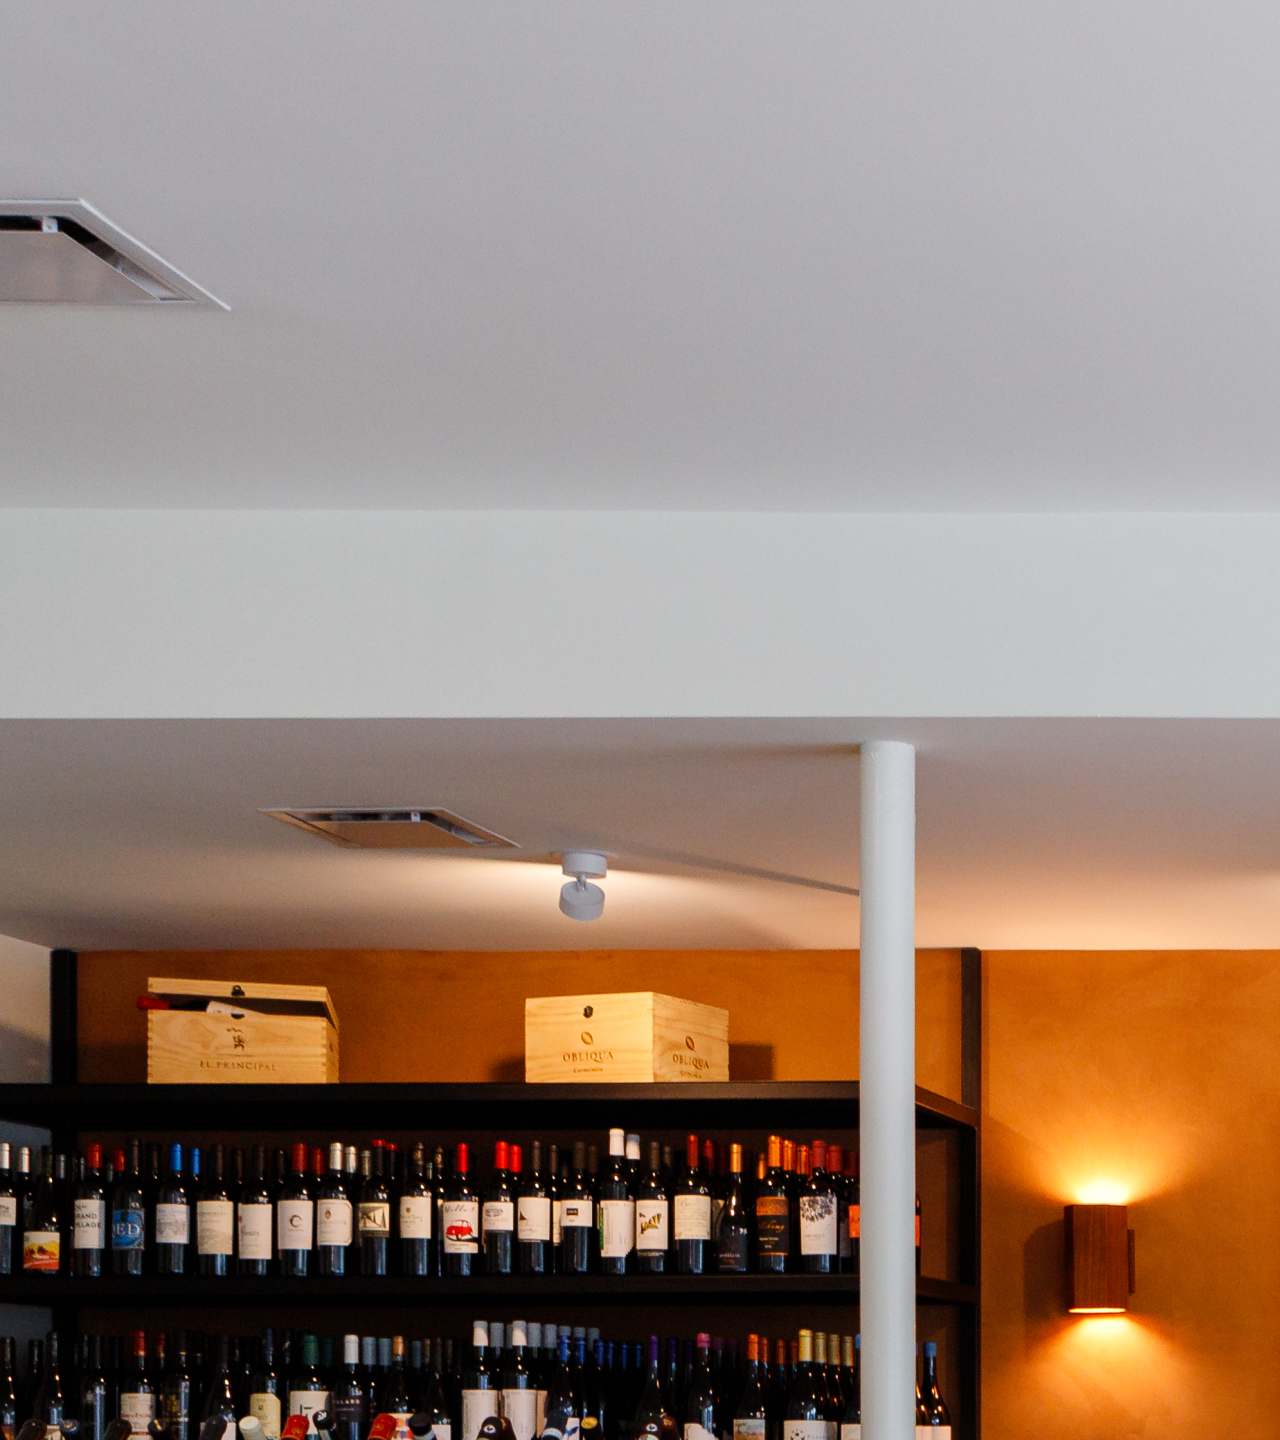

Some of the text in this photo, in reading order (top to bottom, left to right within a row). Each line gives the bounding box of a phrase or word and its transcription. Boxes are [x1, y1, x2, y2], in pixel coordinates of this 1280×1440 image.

[562, 1050, 614, 1063] OBLIQUA
[672, 1053, 710, 1071] OBLIQUA
[215, 1061, 278, 1071] PRINCIPAL
